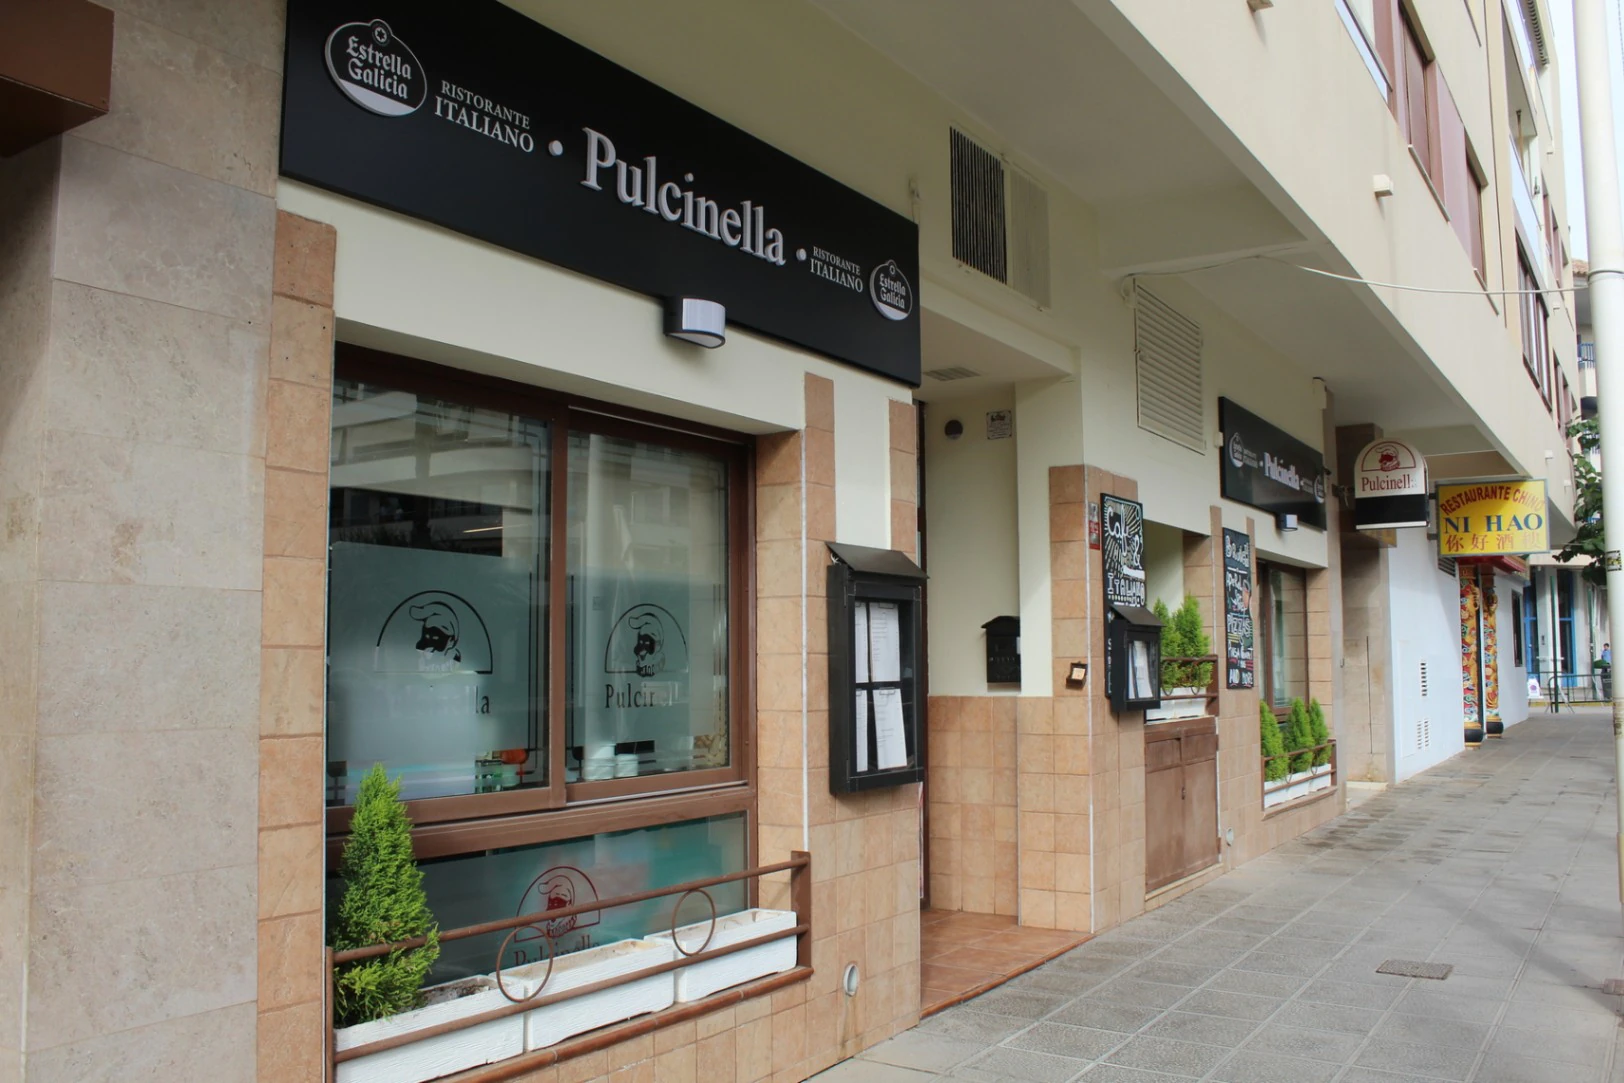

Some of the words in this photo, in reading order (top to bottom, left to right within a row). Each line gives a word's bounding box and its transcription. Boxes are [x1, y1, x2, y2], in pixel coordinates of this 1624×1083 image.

[346, 35, 412, 80] Estrella
[348, 58, 409, 99] Galicia
[441, 80, 530, 129] RISTORANTE
[434, 96, 534, 153] ITALIANO
[580, 126, 786, 266] Pulcinella
[810, 258, 864, 293] ITALIANO
[813, 246, 861, 276] RISTORANTE
[879, 273, 906, 297] Estrella
[880, 287, 906, 309] Galicia
[1440, 485, 1512, 515] RESTAURANTE
[1443, 515, 1472, 534] NI
[1485, 512, 1543, 533] HAO
